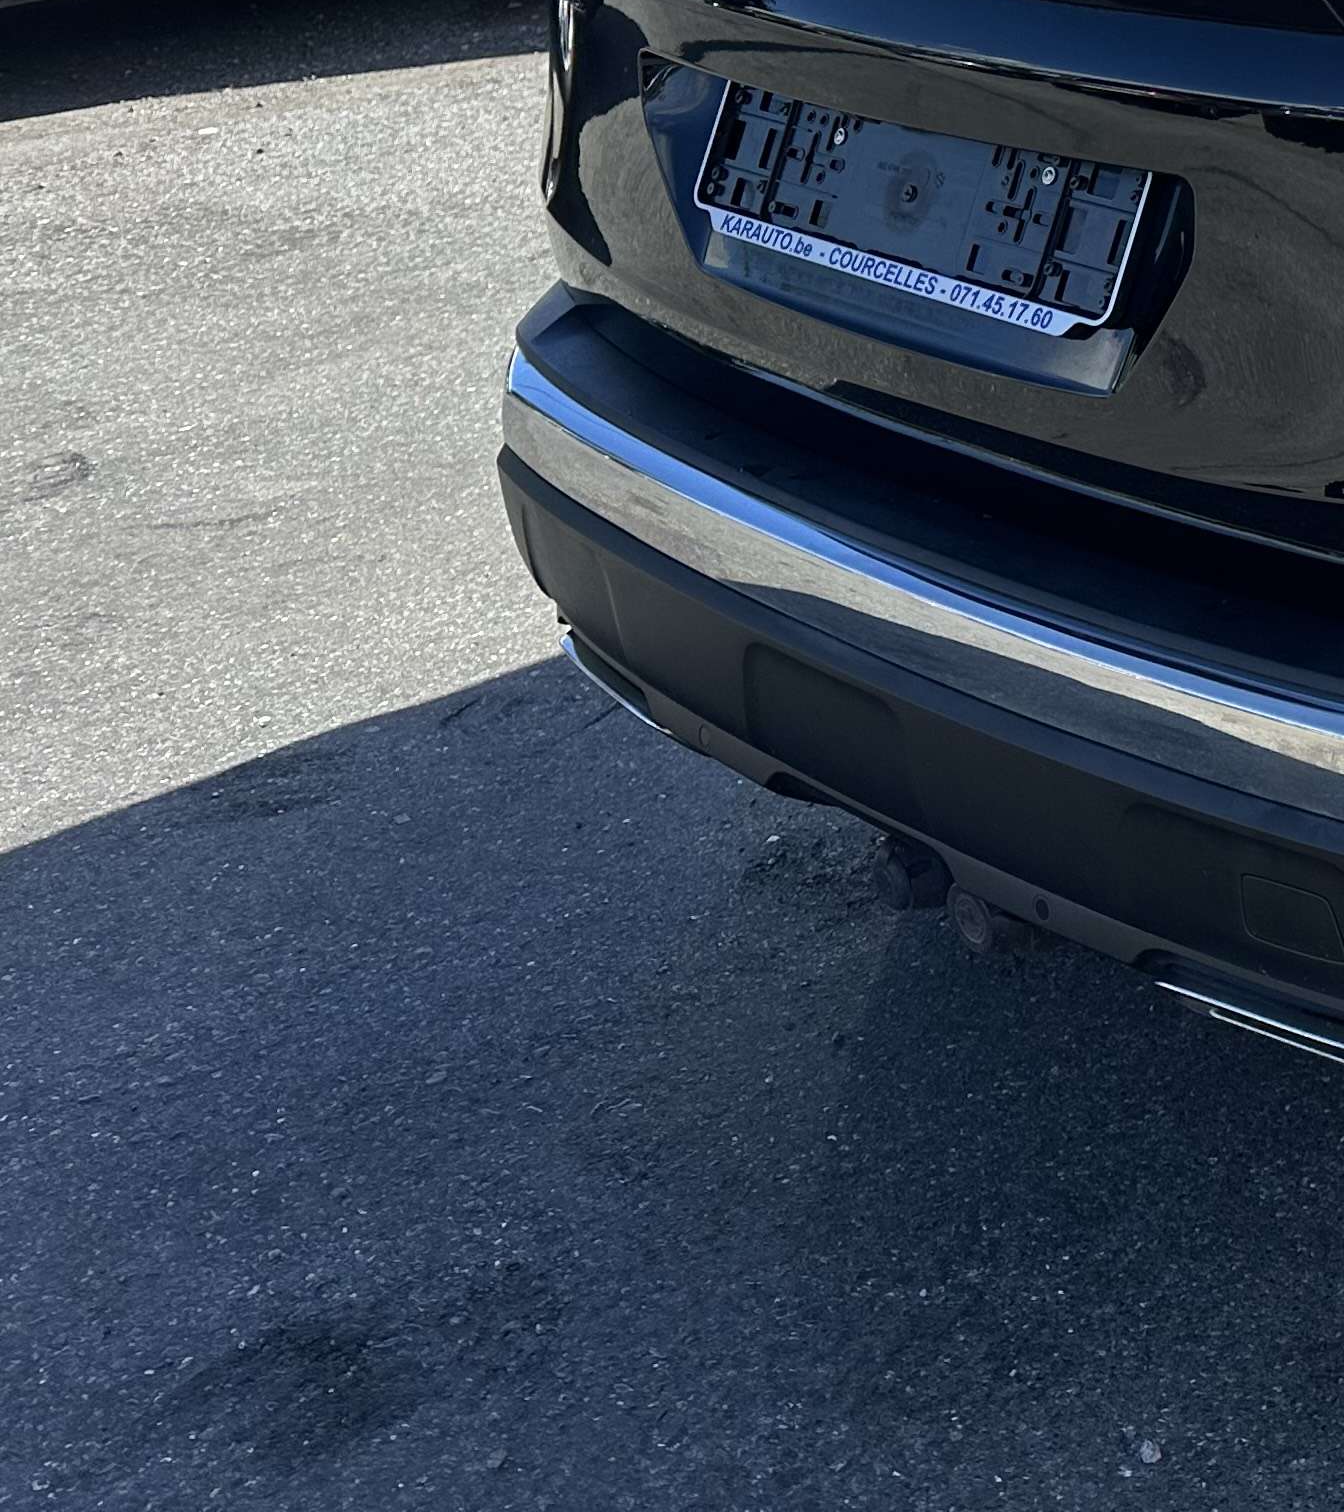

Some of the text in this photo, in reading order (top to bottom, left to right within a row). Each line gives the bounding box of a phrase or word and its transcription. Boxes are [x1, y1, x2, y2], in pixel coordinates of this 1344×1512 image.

[721, 213, 813, 258] KARAUTO.be
[829, 246, 939, 299] COURCELLES
[949, 283, 1054, 330] 071.45.17.60
